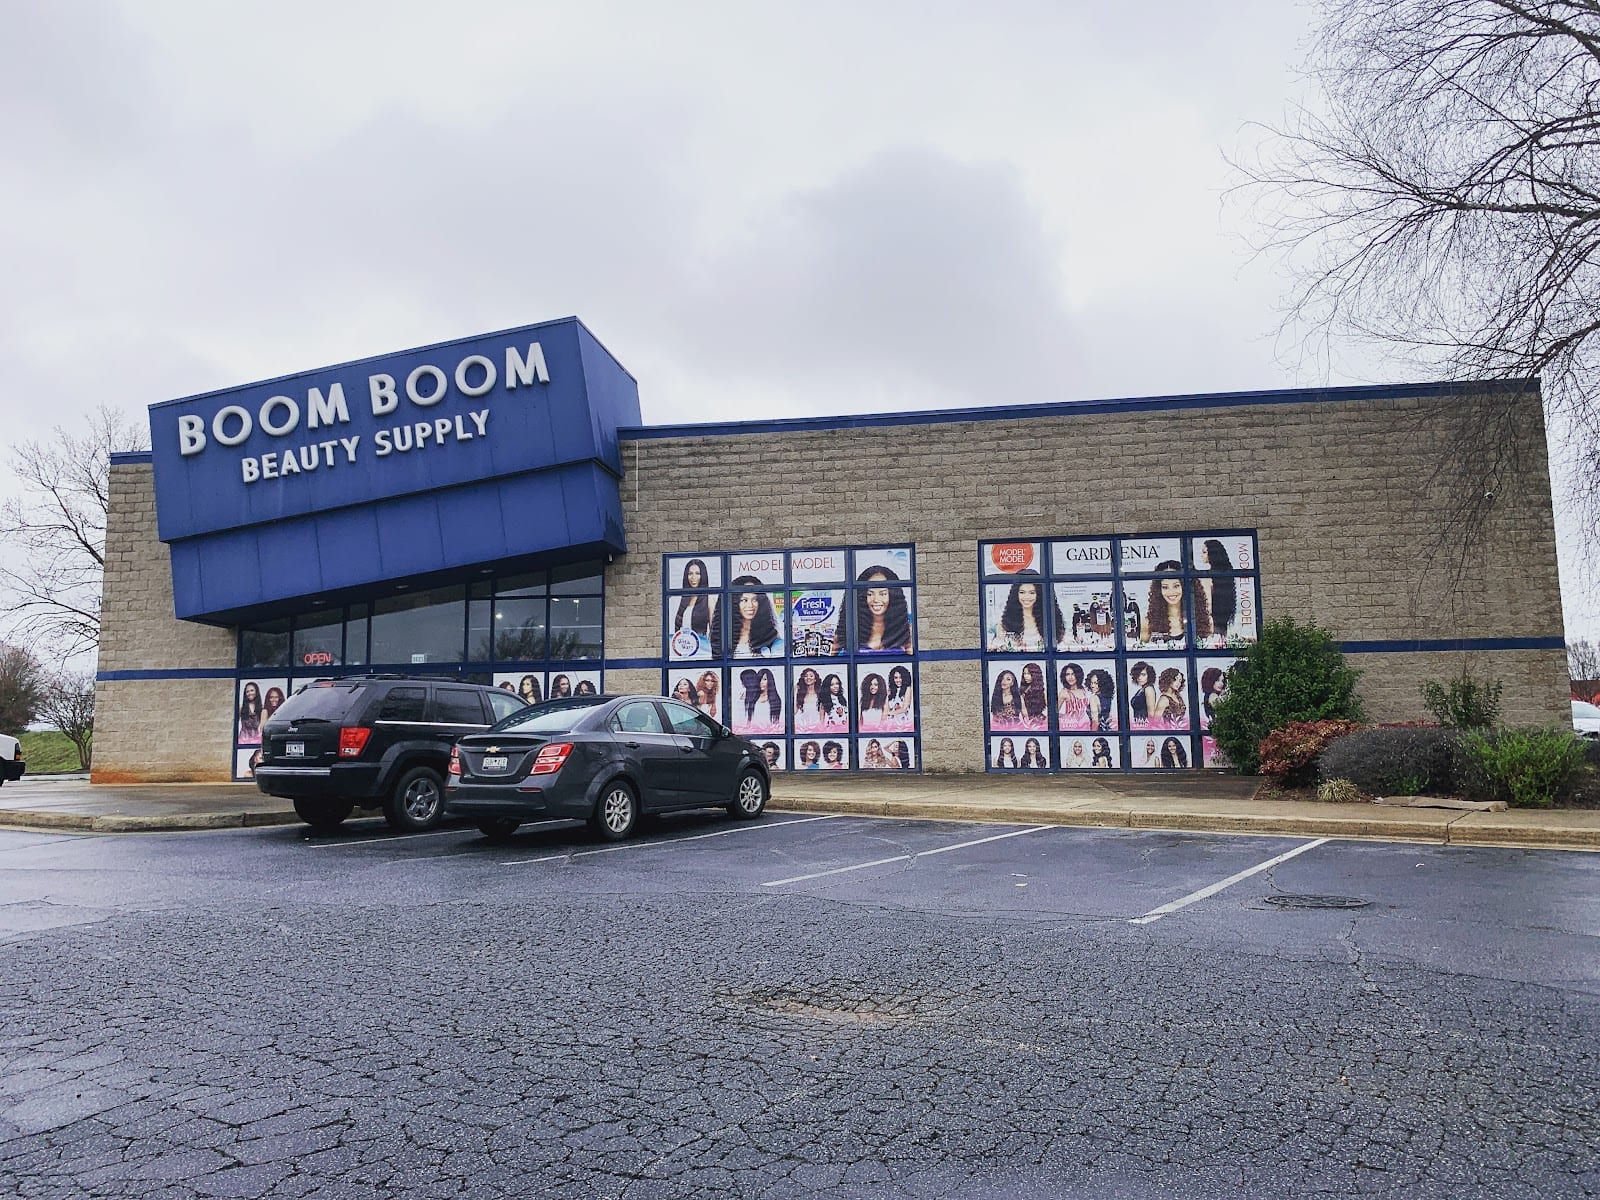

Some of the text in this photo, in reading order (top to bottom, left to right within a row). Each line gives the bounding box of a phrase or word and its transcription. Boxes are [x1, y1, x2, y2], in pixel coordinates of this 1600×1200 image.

[178, 342, 551, 457] BOOM BOOM
[242, 409, 490, 483] BEAUTY SUPPLY
[1000, 548, 1025, 556] MODEL
[739, 557, 835, 571] MODEL MODEL
[801, 598, 825, 608] Fresh
[1240, 590, 1253, 627] MODEL
[304, 653, 331, 664] OPEN
